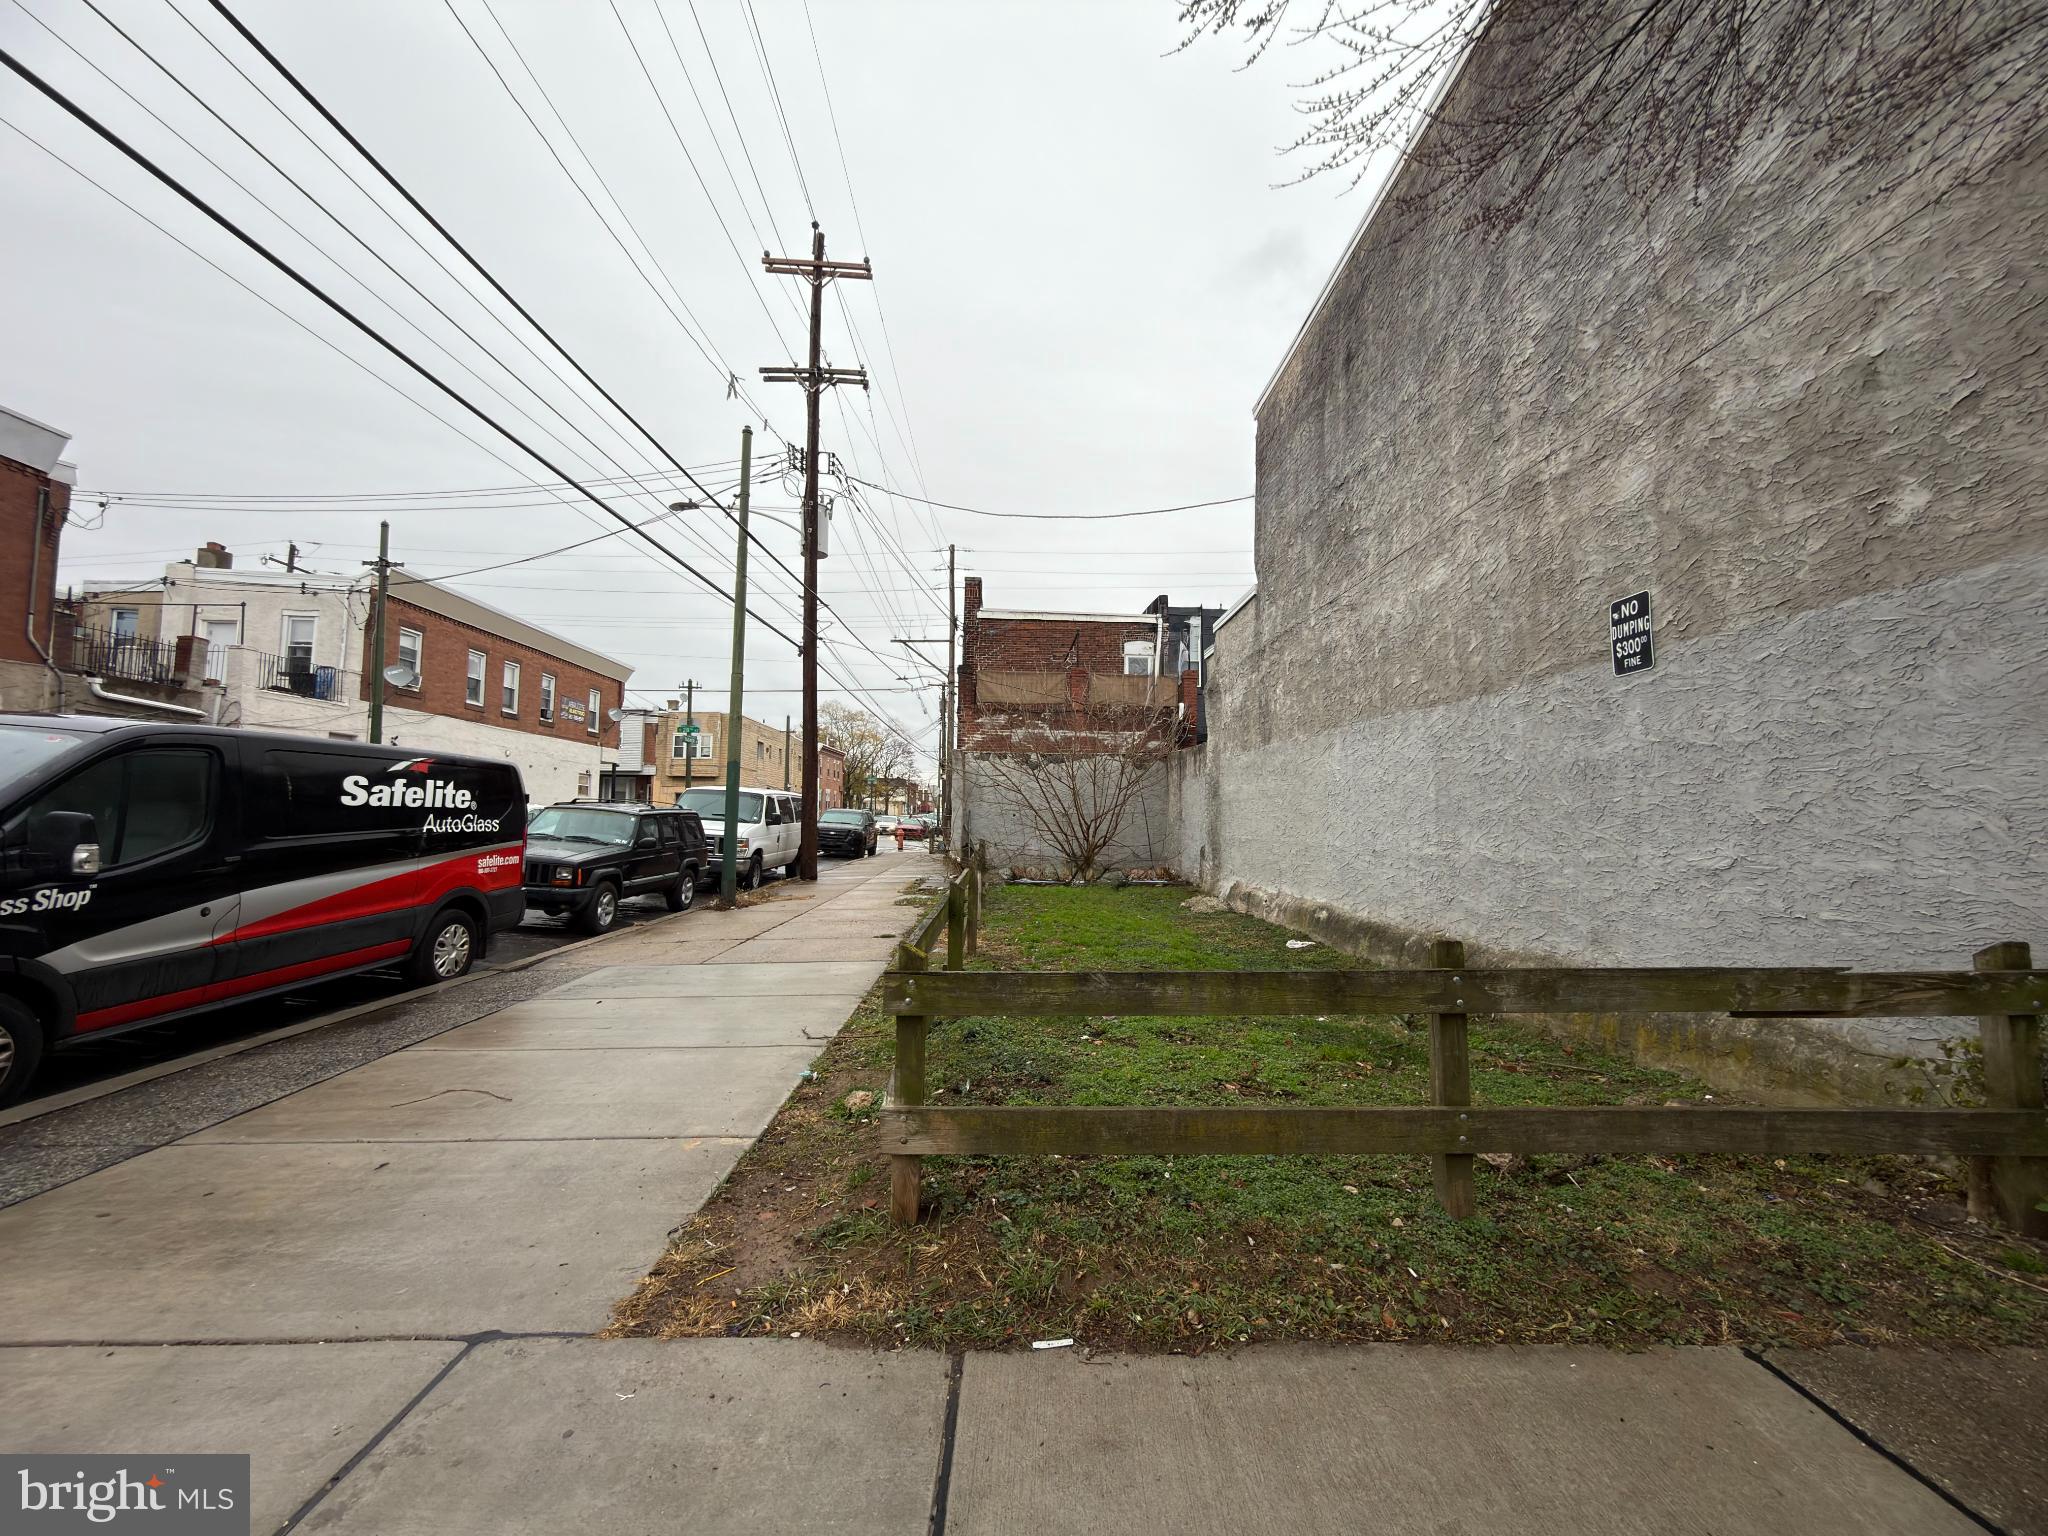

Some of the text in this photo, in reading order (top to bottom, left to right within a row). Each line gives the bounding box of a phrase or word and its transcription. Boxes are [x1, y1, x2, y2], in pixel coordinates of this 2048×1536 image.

[1621, 600, 1639, 618] NO
[1612, 615, 1650, 641] DUMPING
[1624, 656, 1642, 668] FINE
[340, 775, 472, 809] Safelite
[422, 813, 500, 833] AutoGlass
[478, 854, 520, 868] safelite.com
[32, 888, 92, 912] Shop
